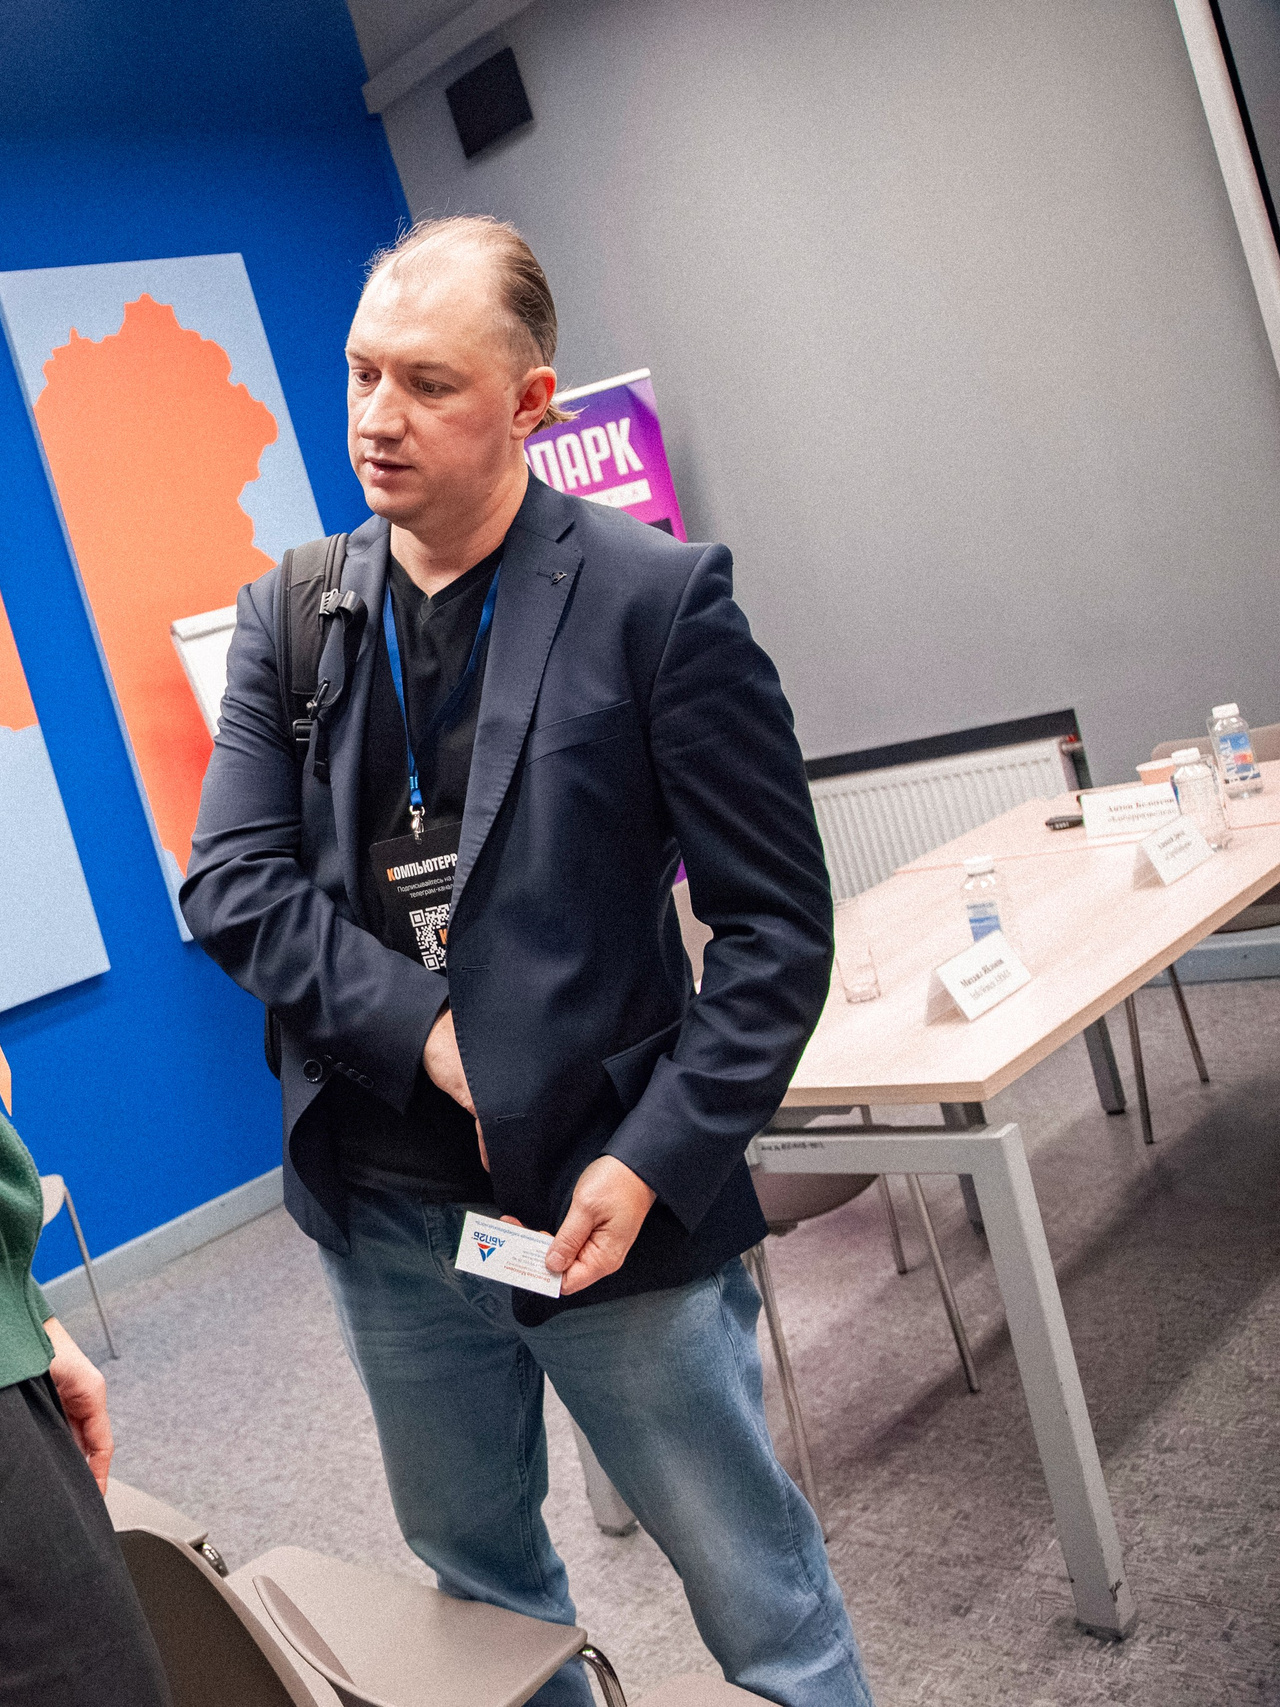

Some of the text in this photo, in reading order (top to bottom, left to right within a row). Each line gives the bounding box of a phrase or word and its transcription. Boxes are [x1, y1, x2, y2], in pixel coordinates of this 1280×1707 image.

[523, 418, 645, 494] ПАРК
[386, 853, 457, 881] КОМПЬЮТЕРР
[397, 877, 443, 893] Подписывайтесь
